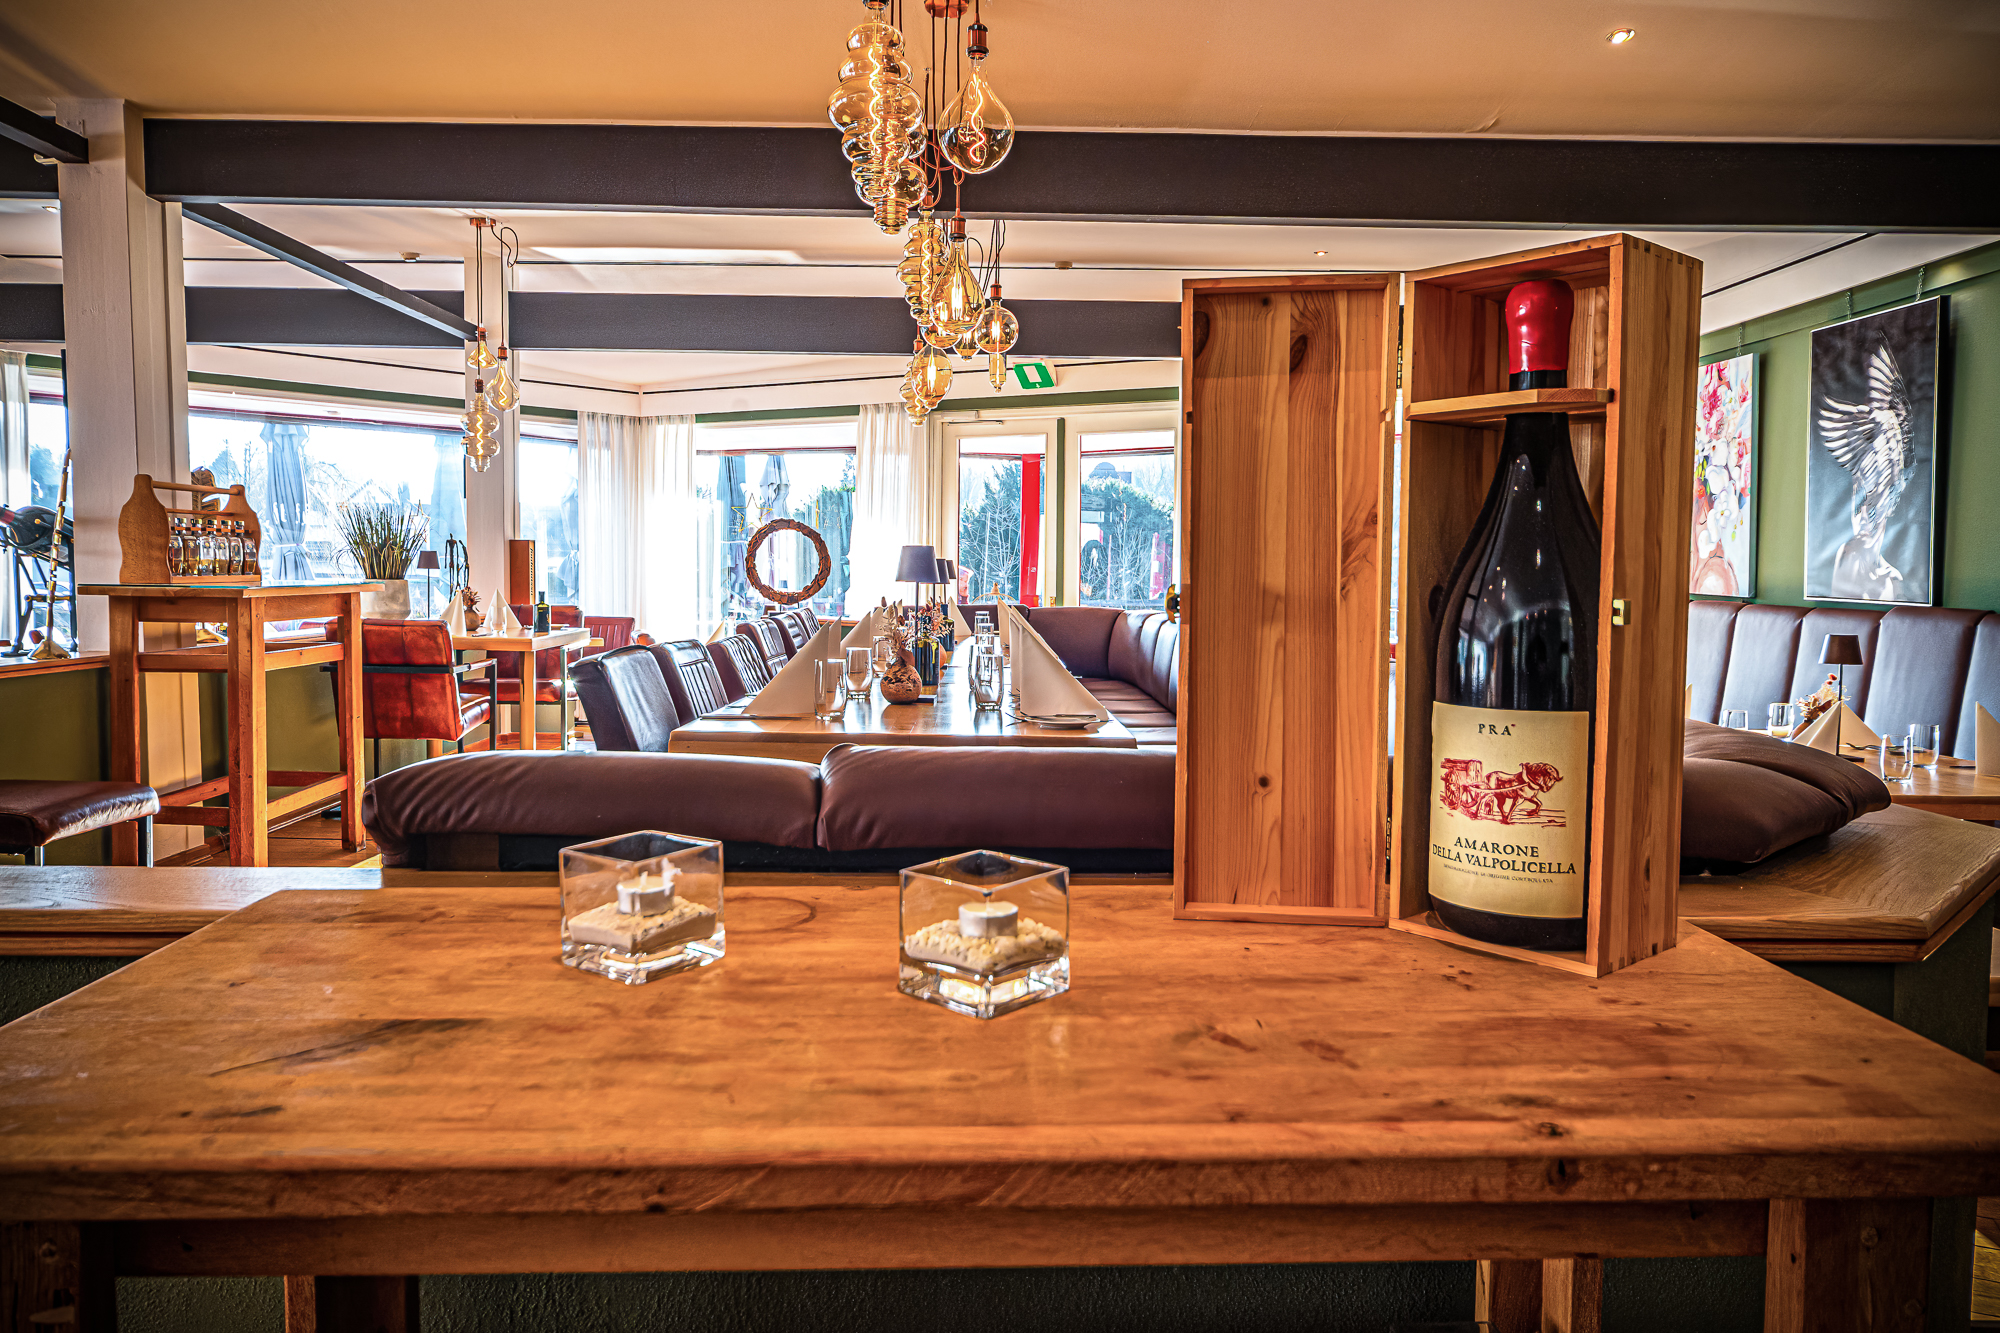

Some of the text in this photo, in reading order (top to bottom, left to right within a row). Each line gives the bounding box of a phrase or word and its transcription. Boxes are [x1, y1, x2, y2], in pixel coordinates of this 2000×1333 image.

[1432, 843, 1577, 874] DELLA VALPOLICELLA
[1454, 836, 1539, 858] AMARONE
